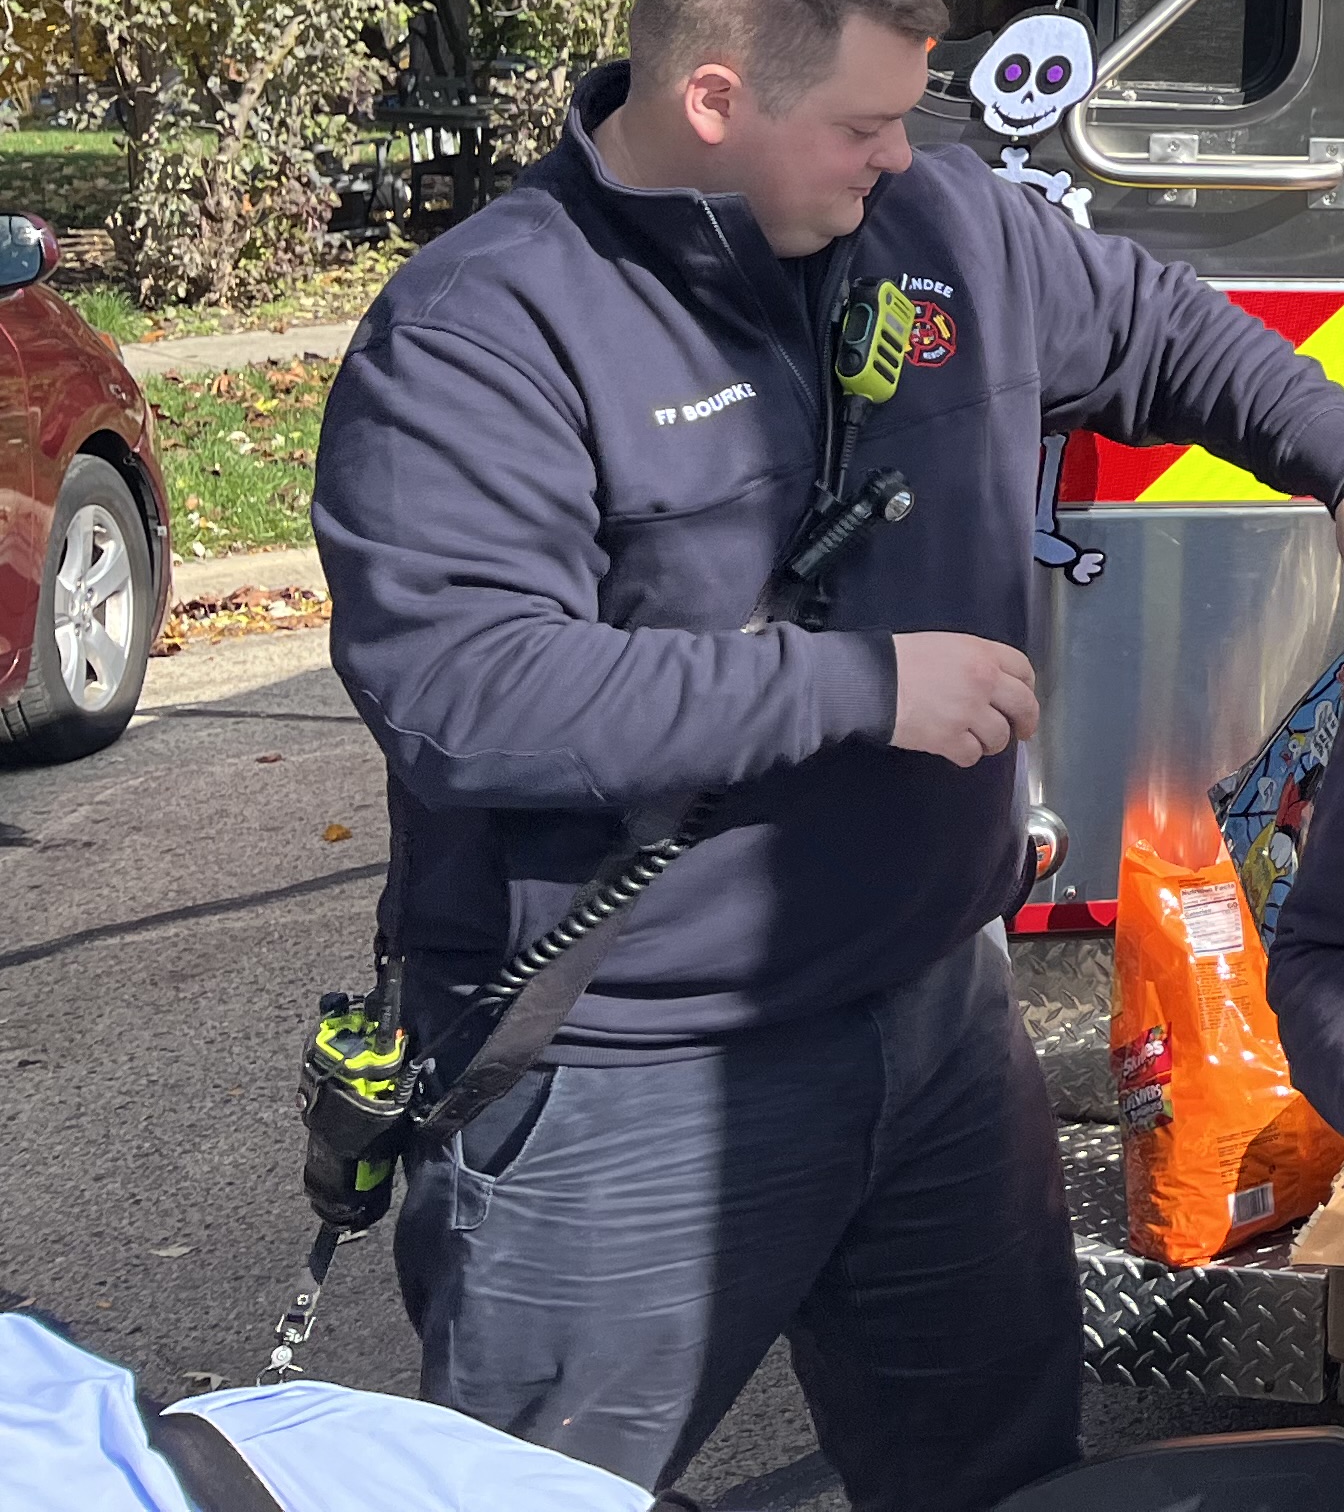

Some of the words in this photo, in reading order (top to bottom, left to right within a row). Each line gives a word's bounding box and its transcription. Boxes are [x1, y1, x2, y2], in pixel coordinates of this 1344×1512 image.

[909, 277, 954, 299] NDEE
[655, 408, 677, 425] FF
[682, 383, 757, 421] BOURKE
